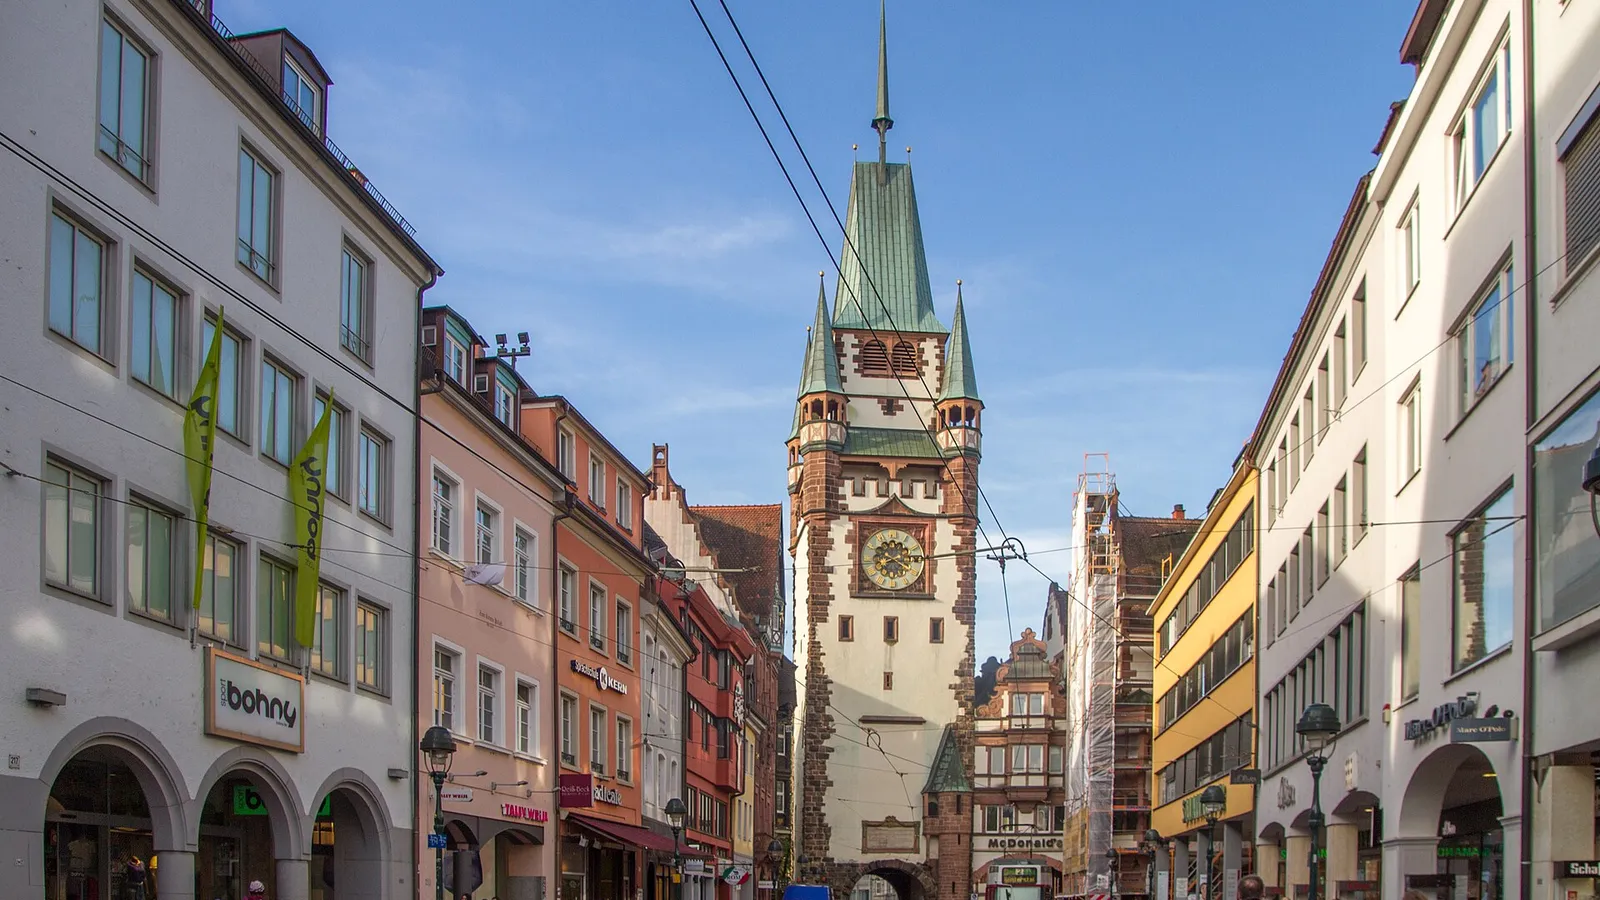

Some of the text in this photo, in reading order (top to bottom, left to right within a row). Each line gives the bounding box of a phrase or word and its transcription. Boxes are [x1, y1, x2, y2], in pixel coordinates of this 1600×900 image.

[608, 676, 628, 695] KERN
[227, 680, 297, 729] bohny
[988, 838, 1064, 849] McDonald's
